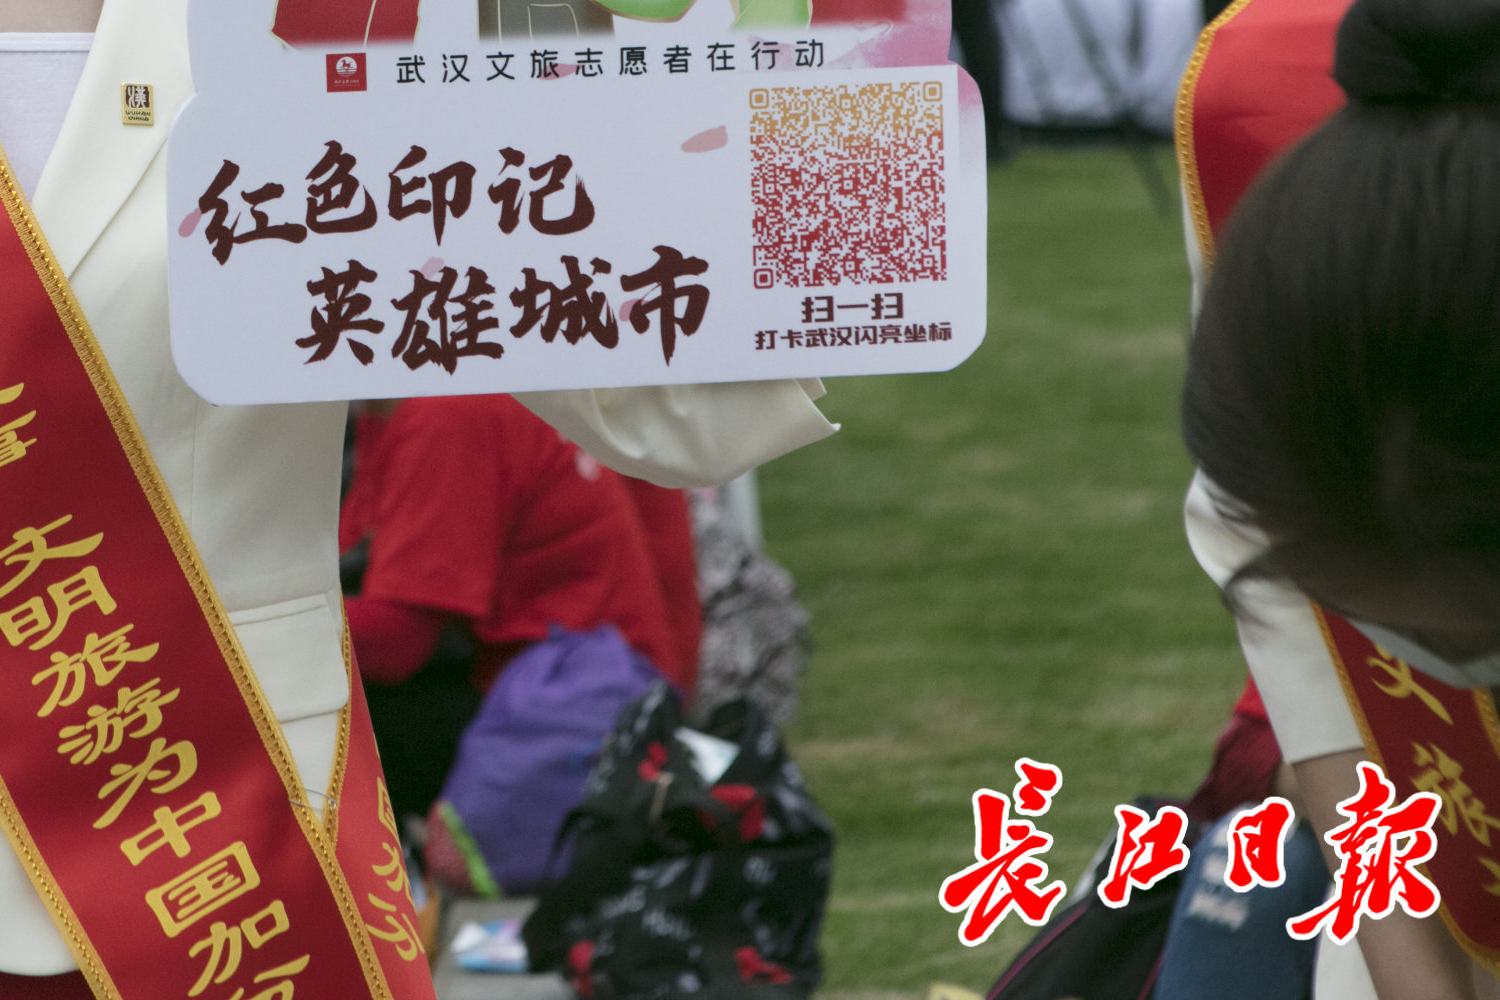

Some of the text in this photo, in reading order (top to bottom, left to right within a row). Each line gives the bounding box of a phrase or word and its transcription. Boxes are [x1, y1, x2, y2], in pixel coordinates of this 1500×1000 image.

[395, 38, 826, 86] 武汉文旅志愿者在行动
[198, 139, 596, 266] 红色印记
[295, 244, 711, 376] 英雄城市
[801, 292, 905, 323] 扫一扫
[754, 321, 953, 352] 打卡武汉闪亮坐标
